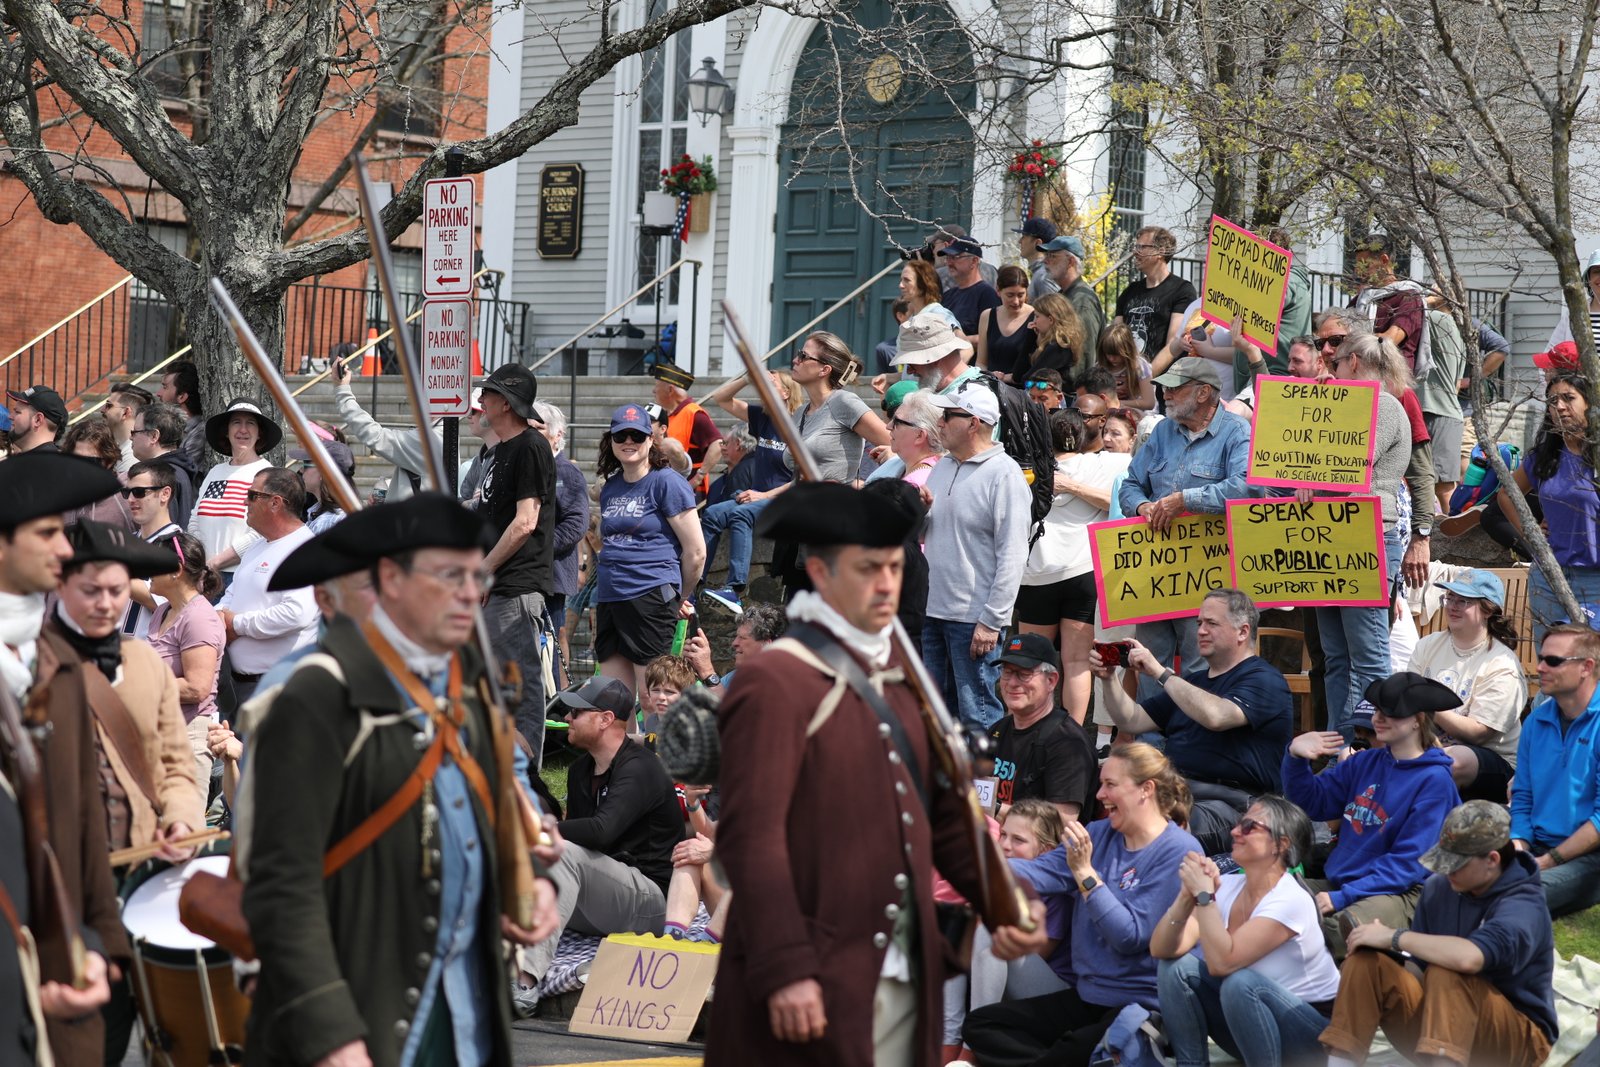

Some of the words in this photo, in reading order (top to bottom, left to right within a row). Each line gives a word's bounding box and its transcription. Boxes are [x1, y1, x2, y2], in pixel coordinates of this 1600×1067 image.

[440, 184, 457, 204] NO
[546, 203, 572, 212] CHURCH
[428, 206, 468, 228] PARKING
[438, 230, 458, 242] HERE
[444, 244, 453, 256] TO
[1212, 225, 1236, 251] STOP
[1235, 236, 1260, 262] MAD
[1262, 248, 1287, 277] KING
[434, 258, 463, 271] CORNER
[1218, 252, 1274, 295] TYRANNY
[441, 309, 453, 327] NO
[1207, 288, 1234, 312] SUPPORT
[1232, 301, 1248, 323] DUE
[1251, 311, 1276, 335] PROCESS
[428, 331, 466, 348] PARKING
[431, 356, 462, 370] MONDAY-
[428, 375, 465, 389] SATURDAY
[1281, 384, 1329, 399] SPEAK
[1332, 387, 1349, 402] UP
[1301, 406, 1332, 423] FOR
[1282, 428, 1312, 443] OUR
[1318, 430, 1369, 446] FUTURE
[1255, 450, 1270, 461] NO
[1273, 451, 1321, 465] GUTTING
[1326, 454, 1372, 468] EDUCATION
[1275, 470, 1289, 479] NO
[1292, 470, 1327, 482] SCIENCE
[1331, 473, 1359, 483] DENIAL
[1248, 502, 1314, 523] SPEAK
[1328, 502, 1359, 524] UP
[1118, 520, 1225, 549] FOUNDERS
[1285, 526, 1332, 544] FOR
[1114, 551, 1142, 570] DID
[1151, 546, 1193, 567] NOT
[1241, 554, 1275, 572] OUR
[1274, 549, 1332, 572] PUBLIC
[1335, 552, 1379, 570] LAND
[1120, 580, 1138, 601] A
[1151, 566, 1223, 599] KING
[1253, 580, 1318, 595] SUPPORT
[1324, 578, 1359, 595] NPS
[627, 949, 679, 990] NO
[590, 995, 676, 1030] KINGS
